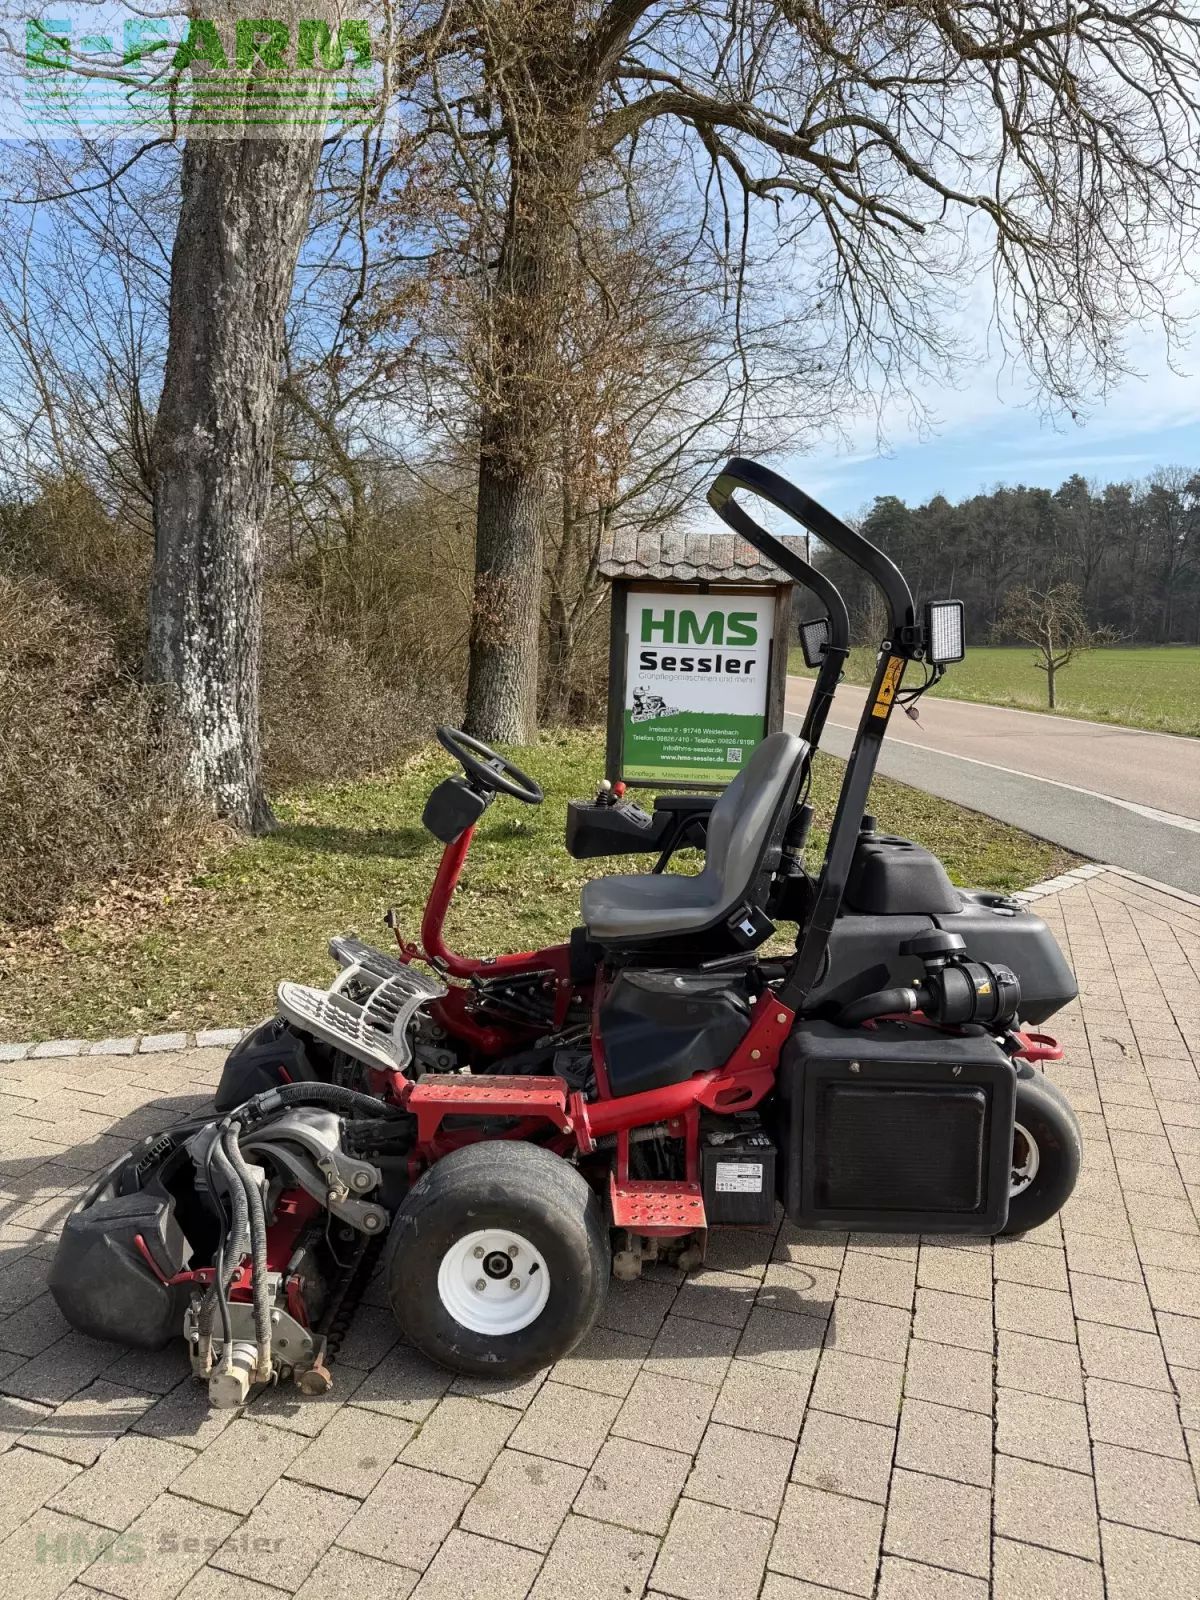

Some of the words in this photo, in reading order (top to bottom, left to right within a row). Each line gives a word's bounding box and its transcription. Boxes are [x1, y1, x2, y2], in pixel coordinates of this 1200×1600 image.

[641, 608, 758, 646] HMS
[639, 651, 757, 675] Sessler
[660, 754, 725, 762] www.hms-sessler.de
